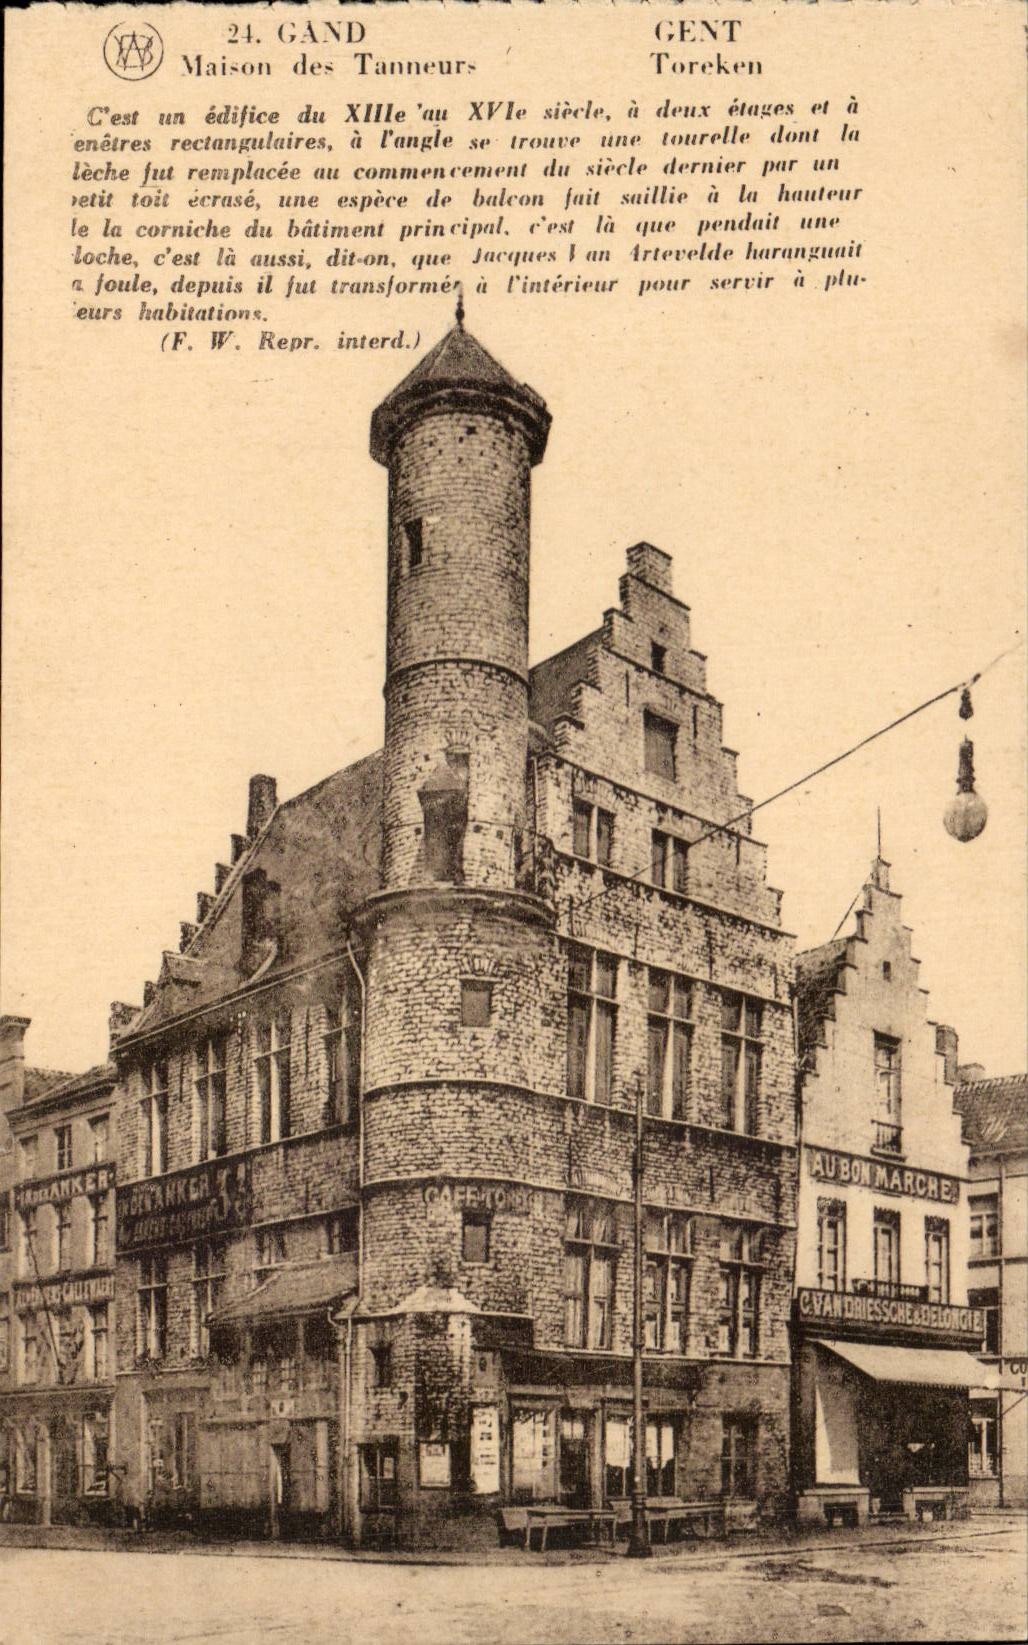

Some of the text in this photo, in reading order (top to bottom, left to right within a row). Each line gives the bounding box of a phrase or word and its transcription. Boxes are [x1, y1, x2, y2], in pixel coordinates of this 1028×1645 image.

[811, 1151, 952, 1201] AU BON MARCHE
